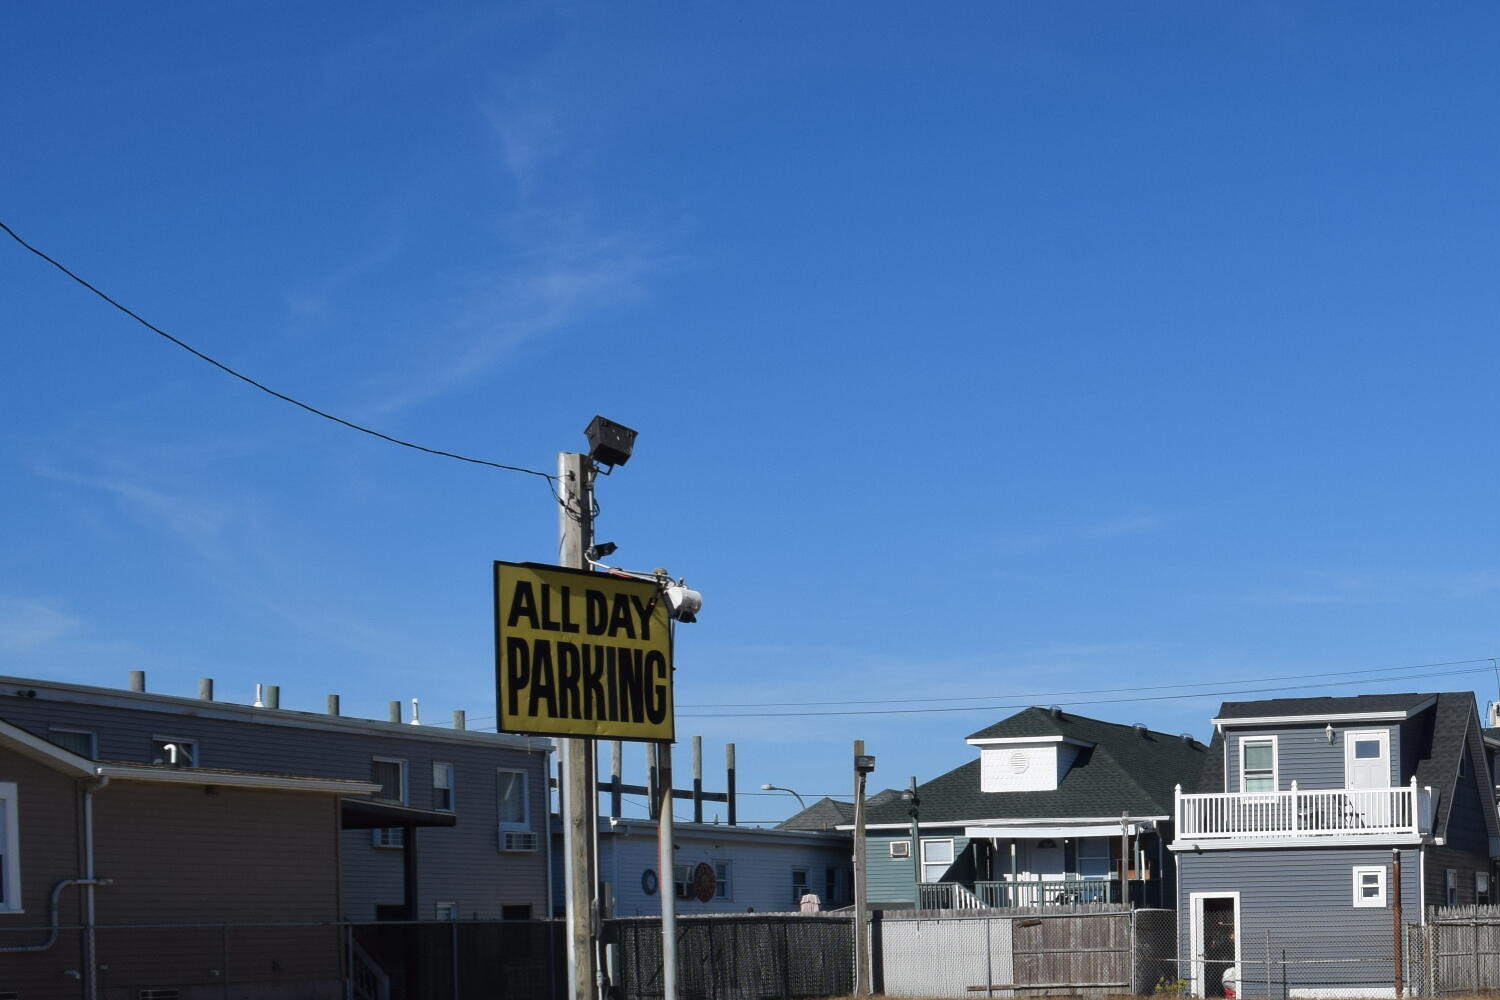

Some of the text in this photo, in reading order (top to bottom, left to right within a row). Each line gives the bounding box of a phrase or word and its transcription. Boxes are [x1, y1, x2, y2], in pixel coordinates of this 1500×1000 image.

[507, 580, 656, 640] ALL DAY
[506, 636, 667, 725] PARKING
